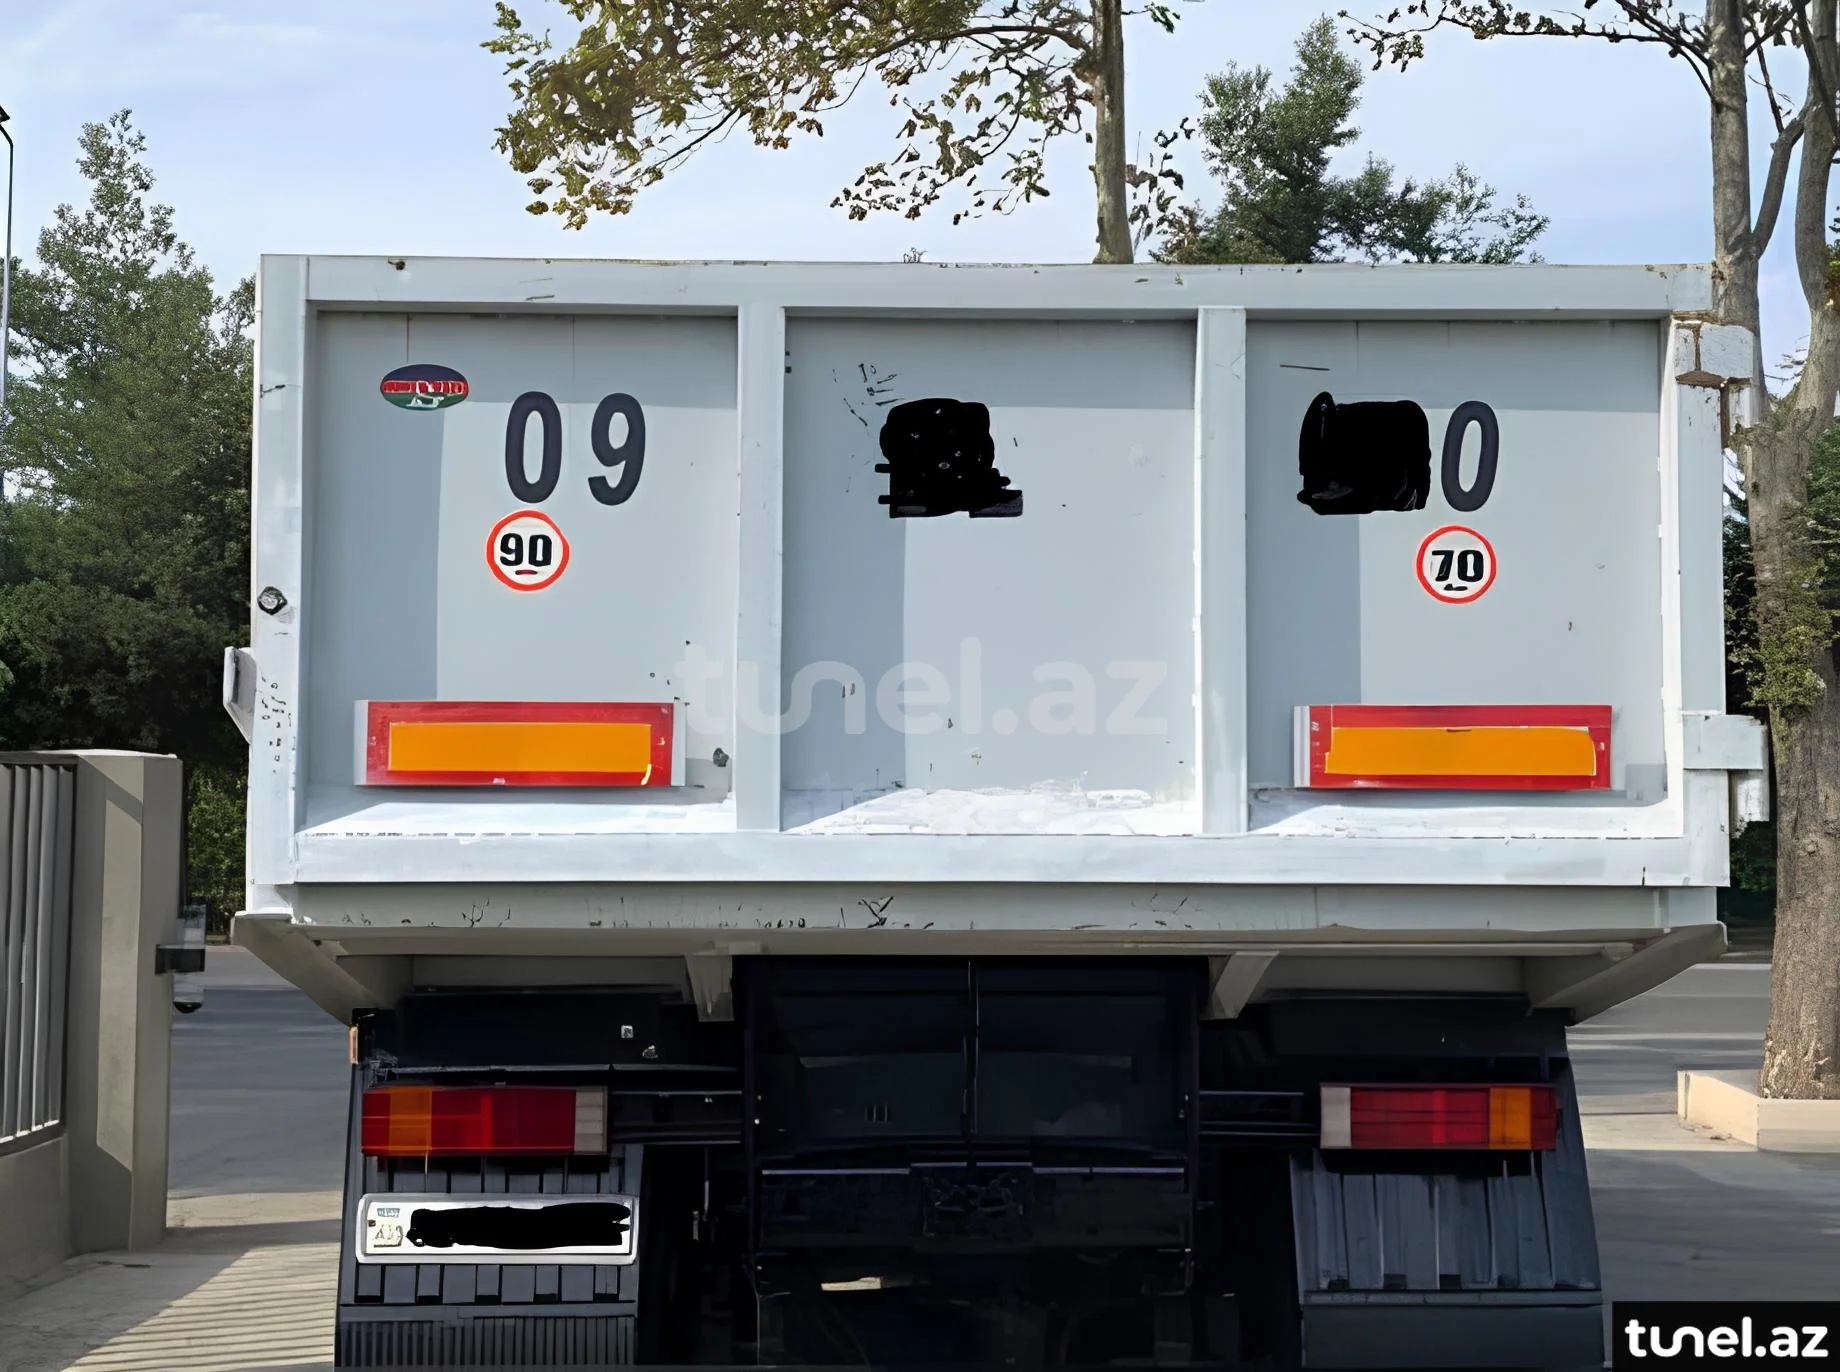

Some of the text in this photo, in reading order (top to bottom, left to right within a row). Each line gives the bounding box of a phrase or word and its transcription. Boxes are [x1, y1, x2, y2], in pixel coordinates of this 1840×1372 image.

[505, 391, 646, 506] 09
[500, 532, 553, 568] 90
[1431, 550, 1485, 583] 70
